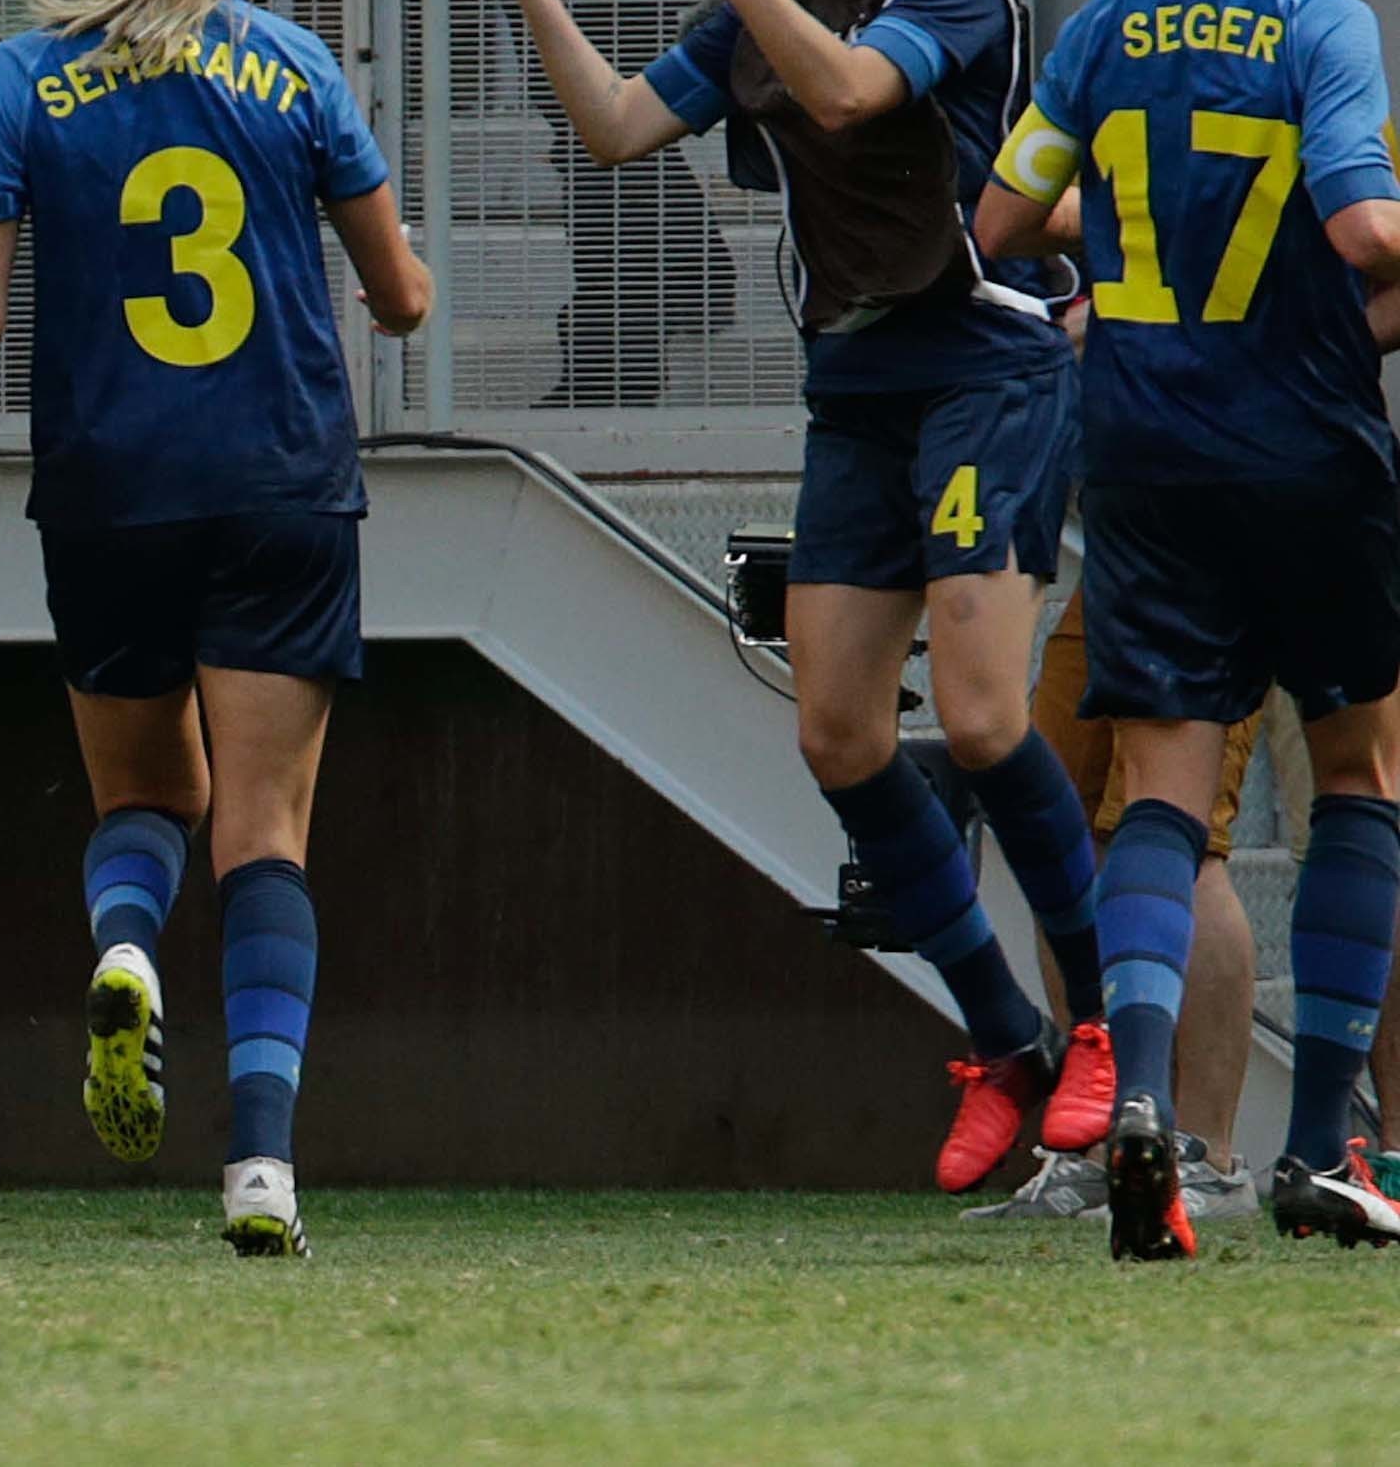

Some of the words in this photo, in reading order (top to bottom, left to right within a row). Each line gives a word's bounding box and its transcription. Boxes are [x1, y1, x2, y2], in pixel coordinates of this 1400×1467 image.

[1122, 4, 1282, 63] SEGER
[120, 147, 255, 367] 3
[1092, 110, 1299, 324] 17
[931, 465, 984, 547] 4
